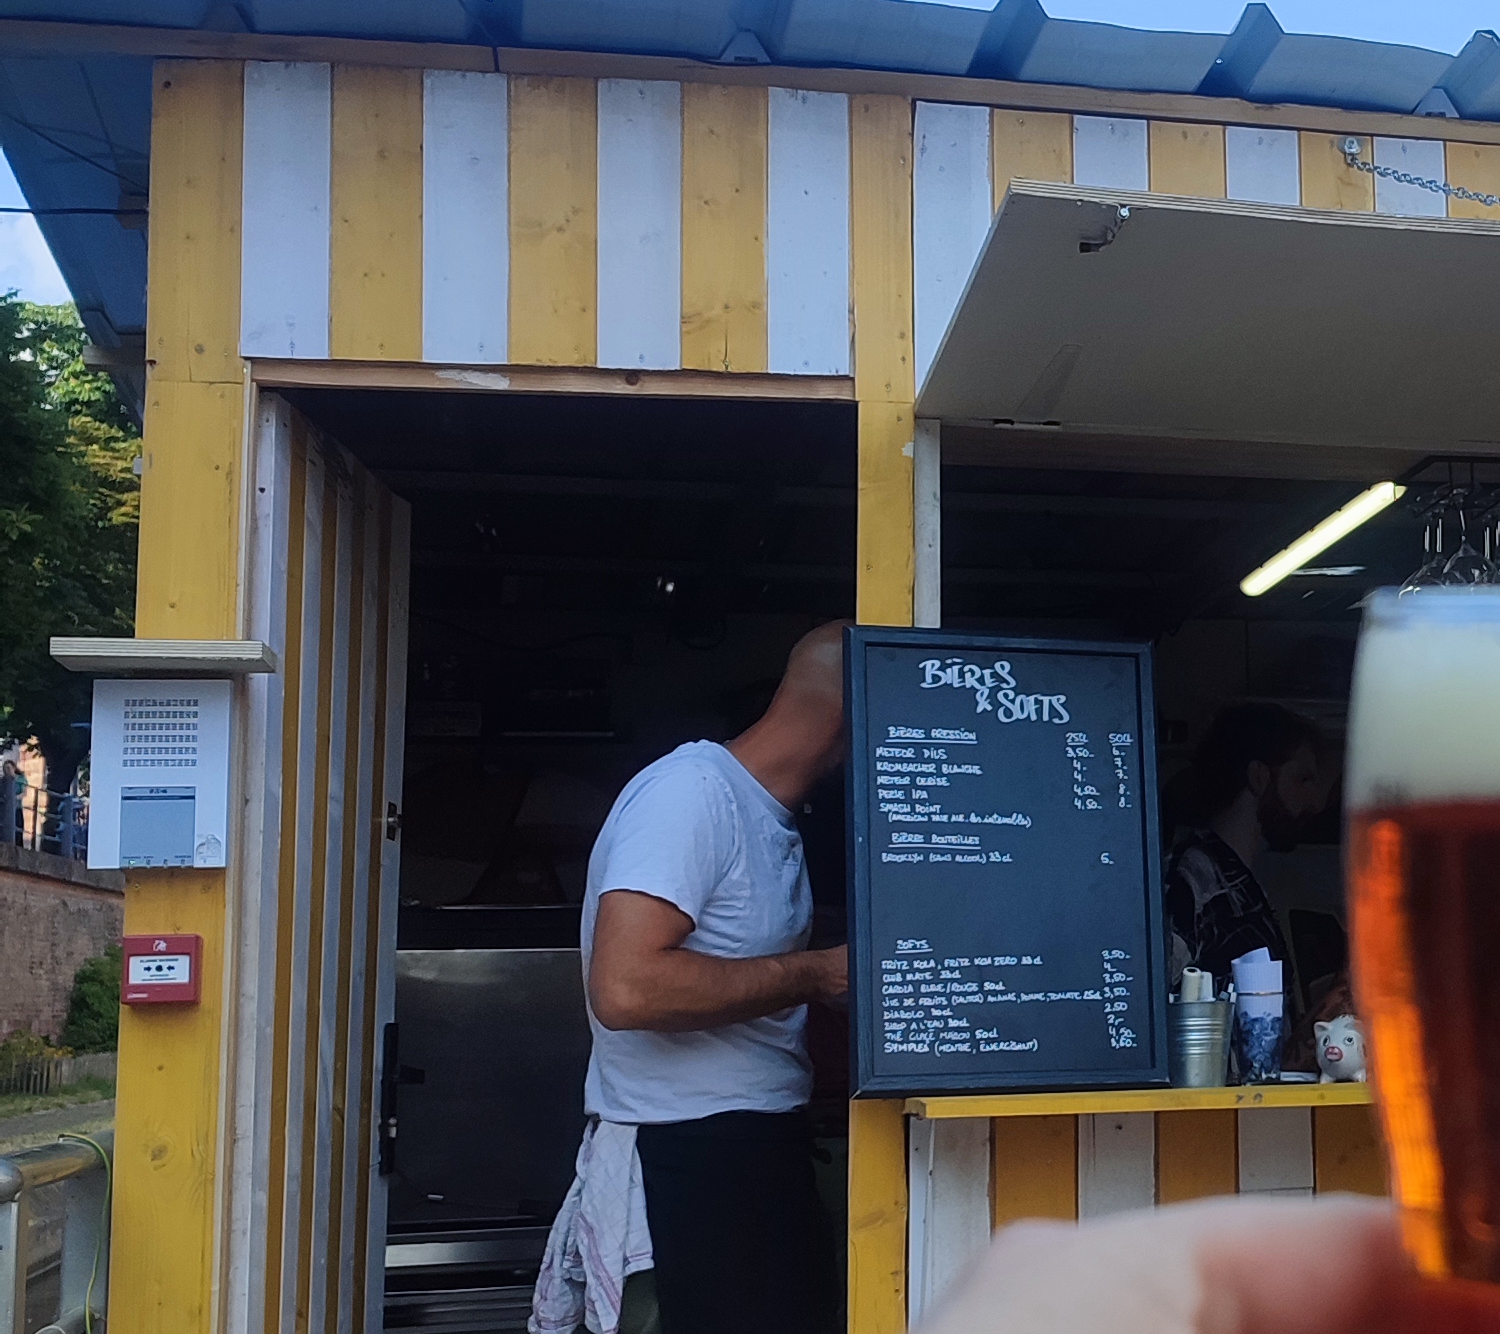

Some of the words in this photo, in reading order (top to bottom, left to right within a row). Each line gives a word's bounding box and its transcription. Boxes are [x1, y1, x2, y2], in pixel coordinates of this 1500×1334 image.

[976, 688, 993, 714] &
[997, 689, 1070, 724] SOFTS
[912, 789, 928, 799] IPA
